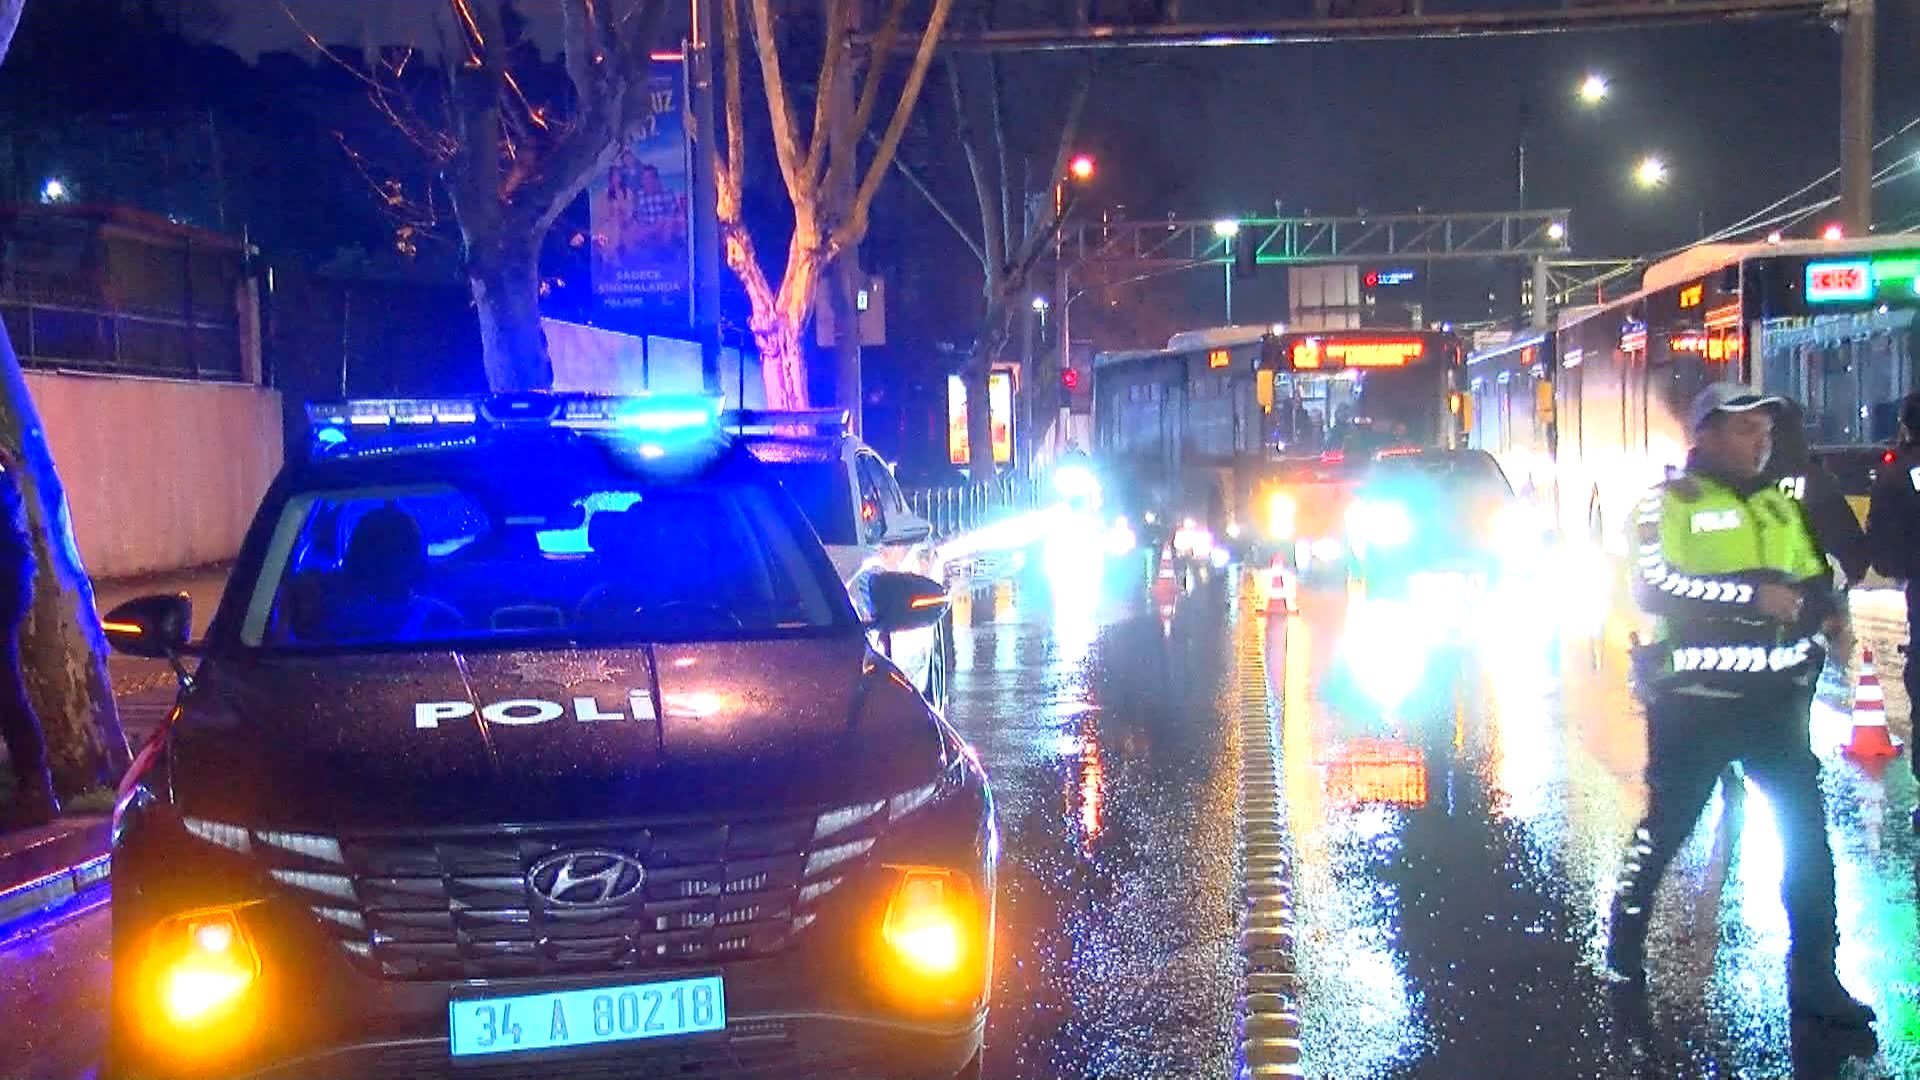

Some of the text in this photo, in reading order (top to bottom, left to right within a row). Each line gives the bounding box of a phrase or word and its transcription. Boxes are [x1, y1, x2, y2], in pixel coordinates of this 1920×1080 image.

[475, 985, 713, 1046] 34 A 80218
